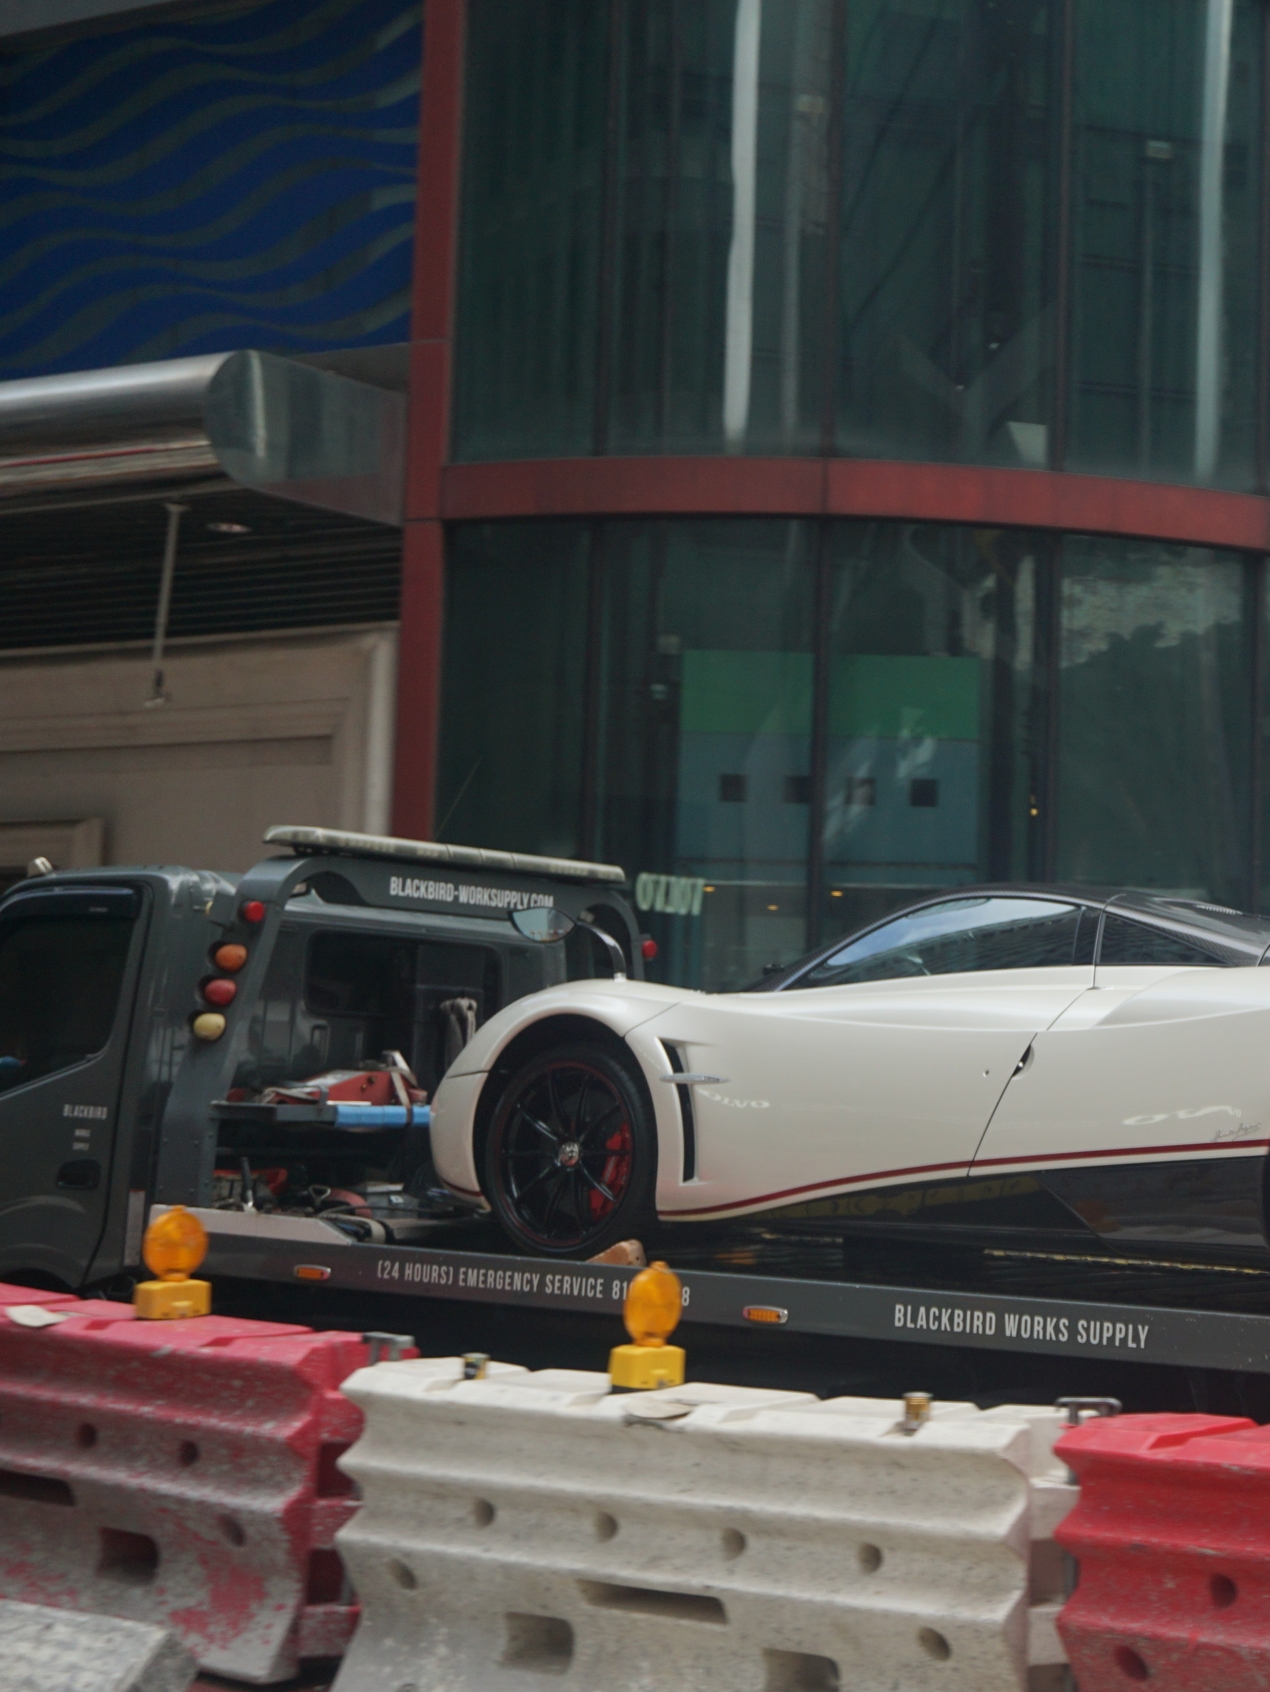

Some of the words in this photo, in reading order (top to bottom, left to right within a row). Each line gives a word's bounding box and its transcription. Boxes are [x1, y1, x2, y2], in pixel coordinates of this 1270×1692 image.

[377, 1260, 399, 1280] (24
[404, 1262, 454, 1285] HOURS)
[459, 1267, 541, 1292] EMERGENCY
[545, 1274, 604, 1298] SERVICE
[894, 1304, 996, 1336] BLACKBIRD
[1005, 1313, 1069, 1342] WORKS
[1077, 1319, 1149, 1349] SUPPLY
